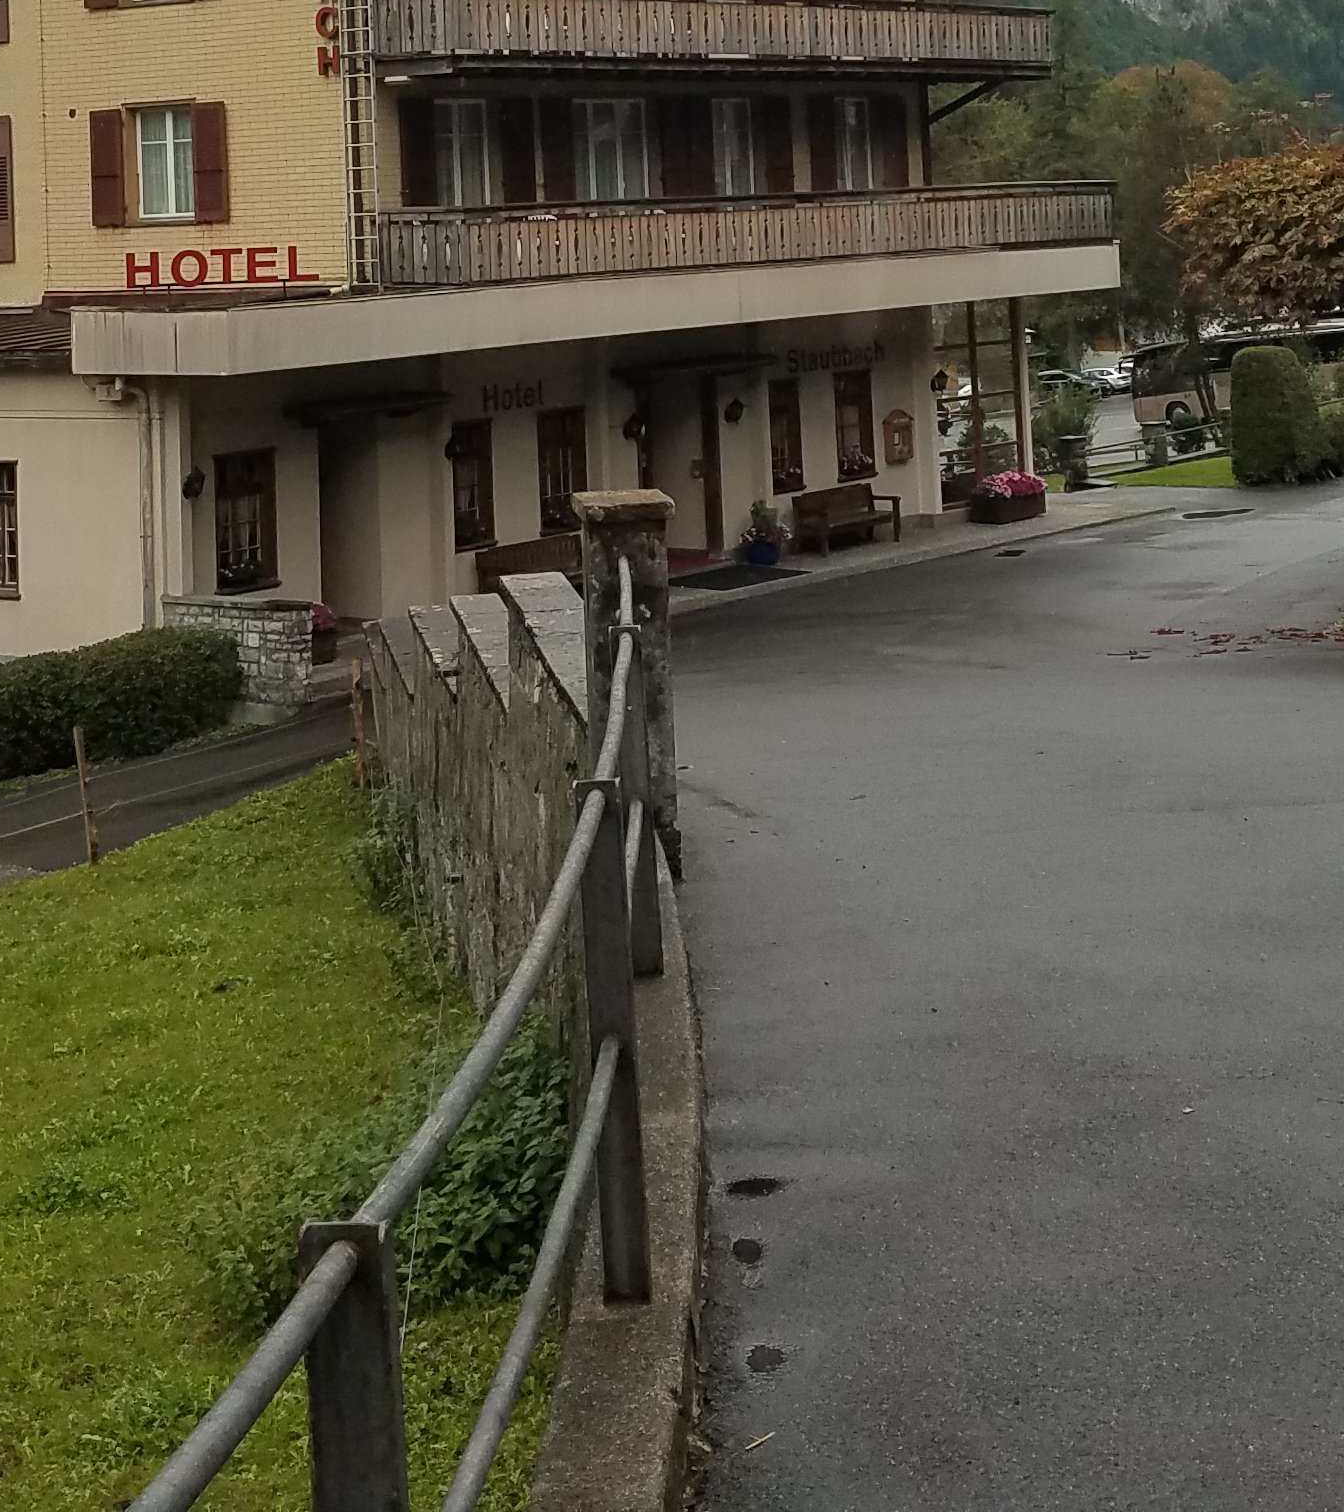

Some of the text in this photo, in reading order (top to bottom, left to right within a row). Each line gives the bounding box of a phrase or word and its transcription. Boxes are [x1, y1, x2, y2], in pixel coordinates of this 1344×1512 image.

[126, 246, 320, 288] HOTEL
[482, 340, 885, 412] Hotel Staubbach
